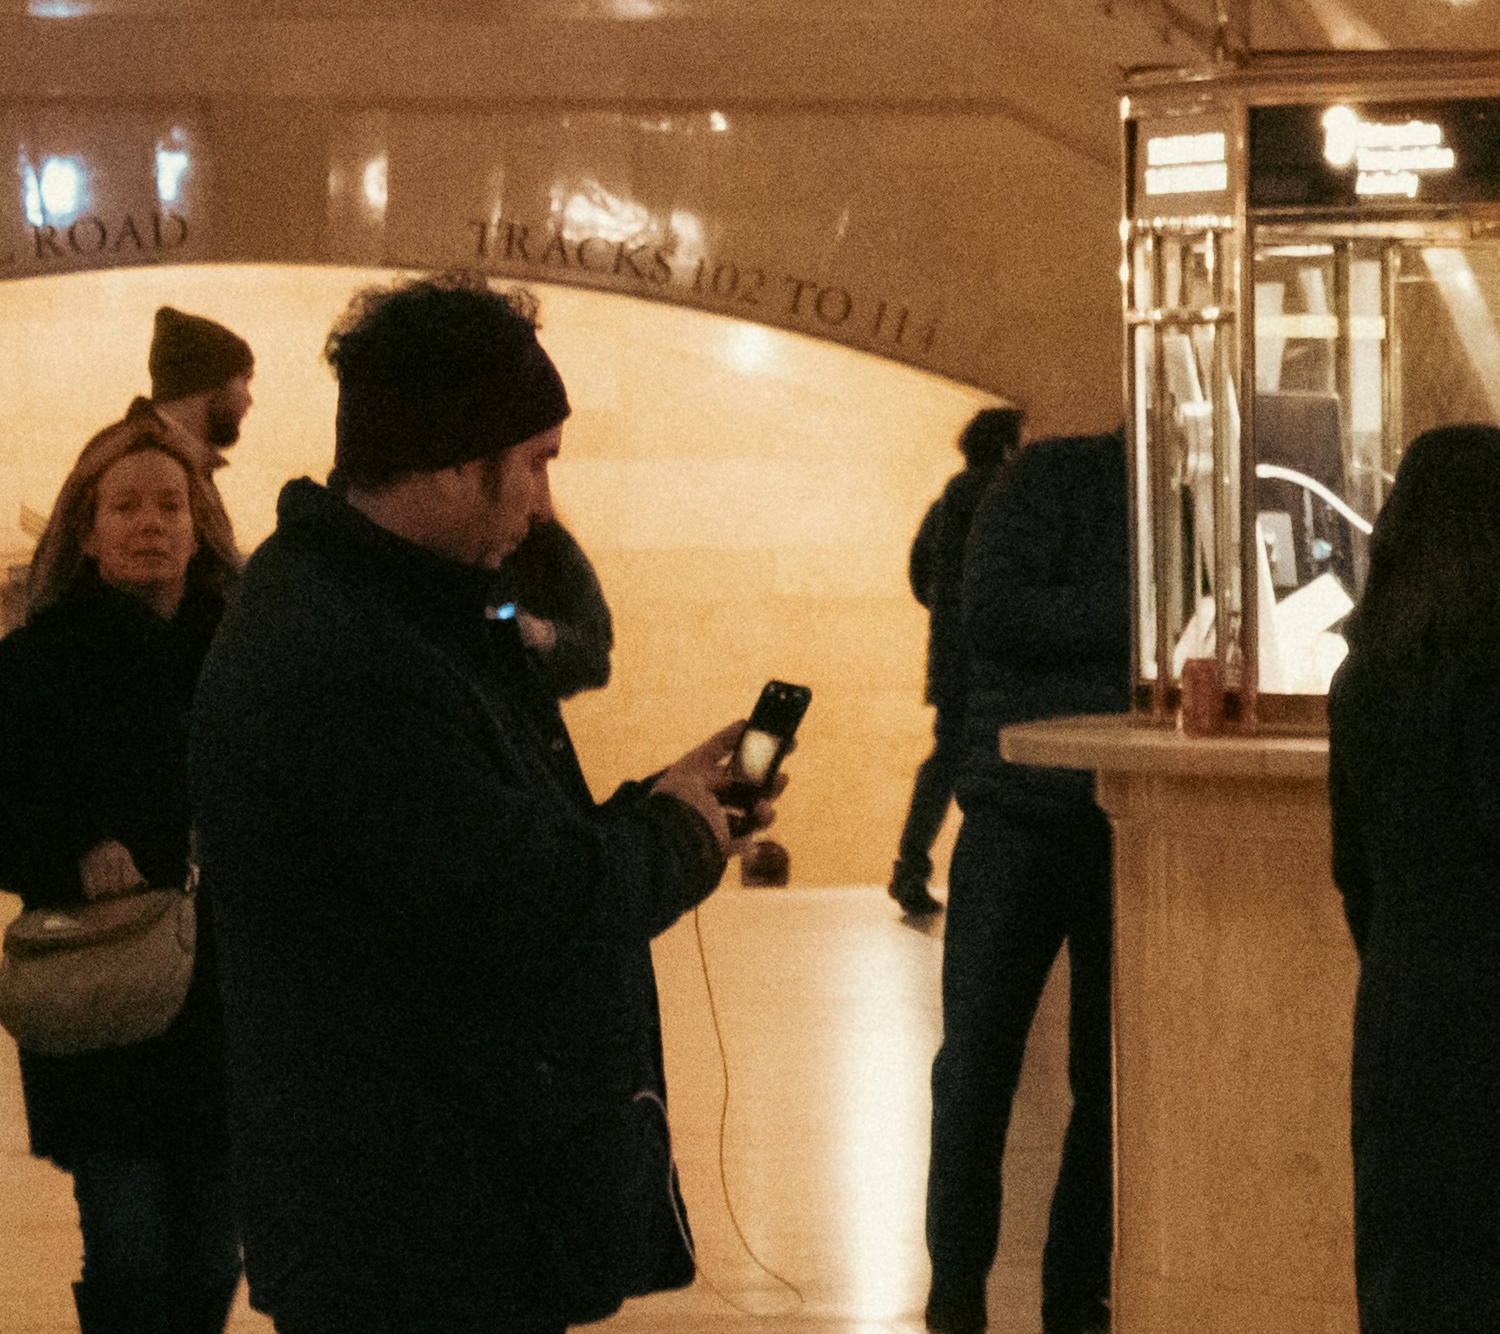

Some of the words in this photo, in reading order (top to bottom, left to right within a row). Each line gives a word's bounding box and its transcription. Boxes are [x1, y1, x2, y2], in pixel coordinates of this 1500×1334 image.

[34, 211, 188, 259] ROAD
[467, 219, 672, 286] TRACKS
[696, 260, 766, 307] 102
[785, 273, 853, 326] TO
